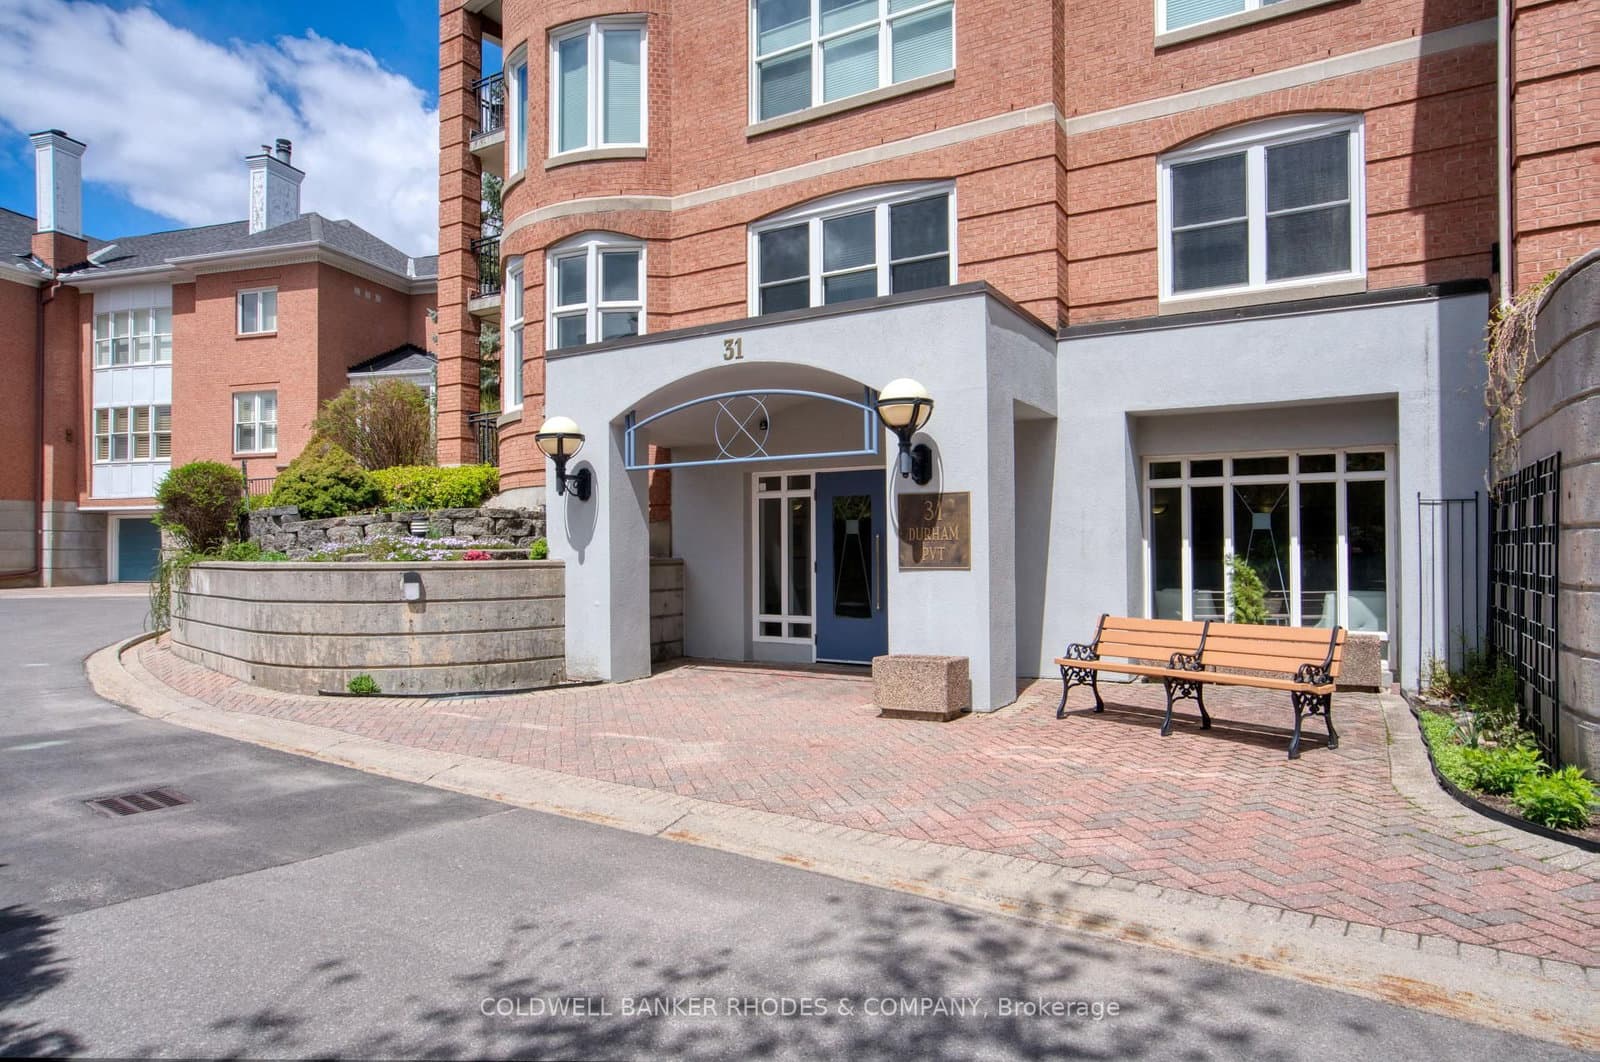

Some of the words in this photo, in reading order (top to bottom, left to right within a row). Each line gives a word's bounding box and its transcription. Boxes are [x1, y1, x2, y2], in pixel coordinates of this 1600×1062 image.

[723, 337, 744, 361] 31
[924, 500, 943, 521] 31
[908, 526, 959, 541] DURHAM
[922, 546, 945, 561] PVT
